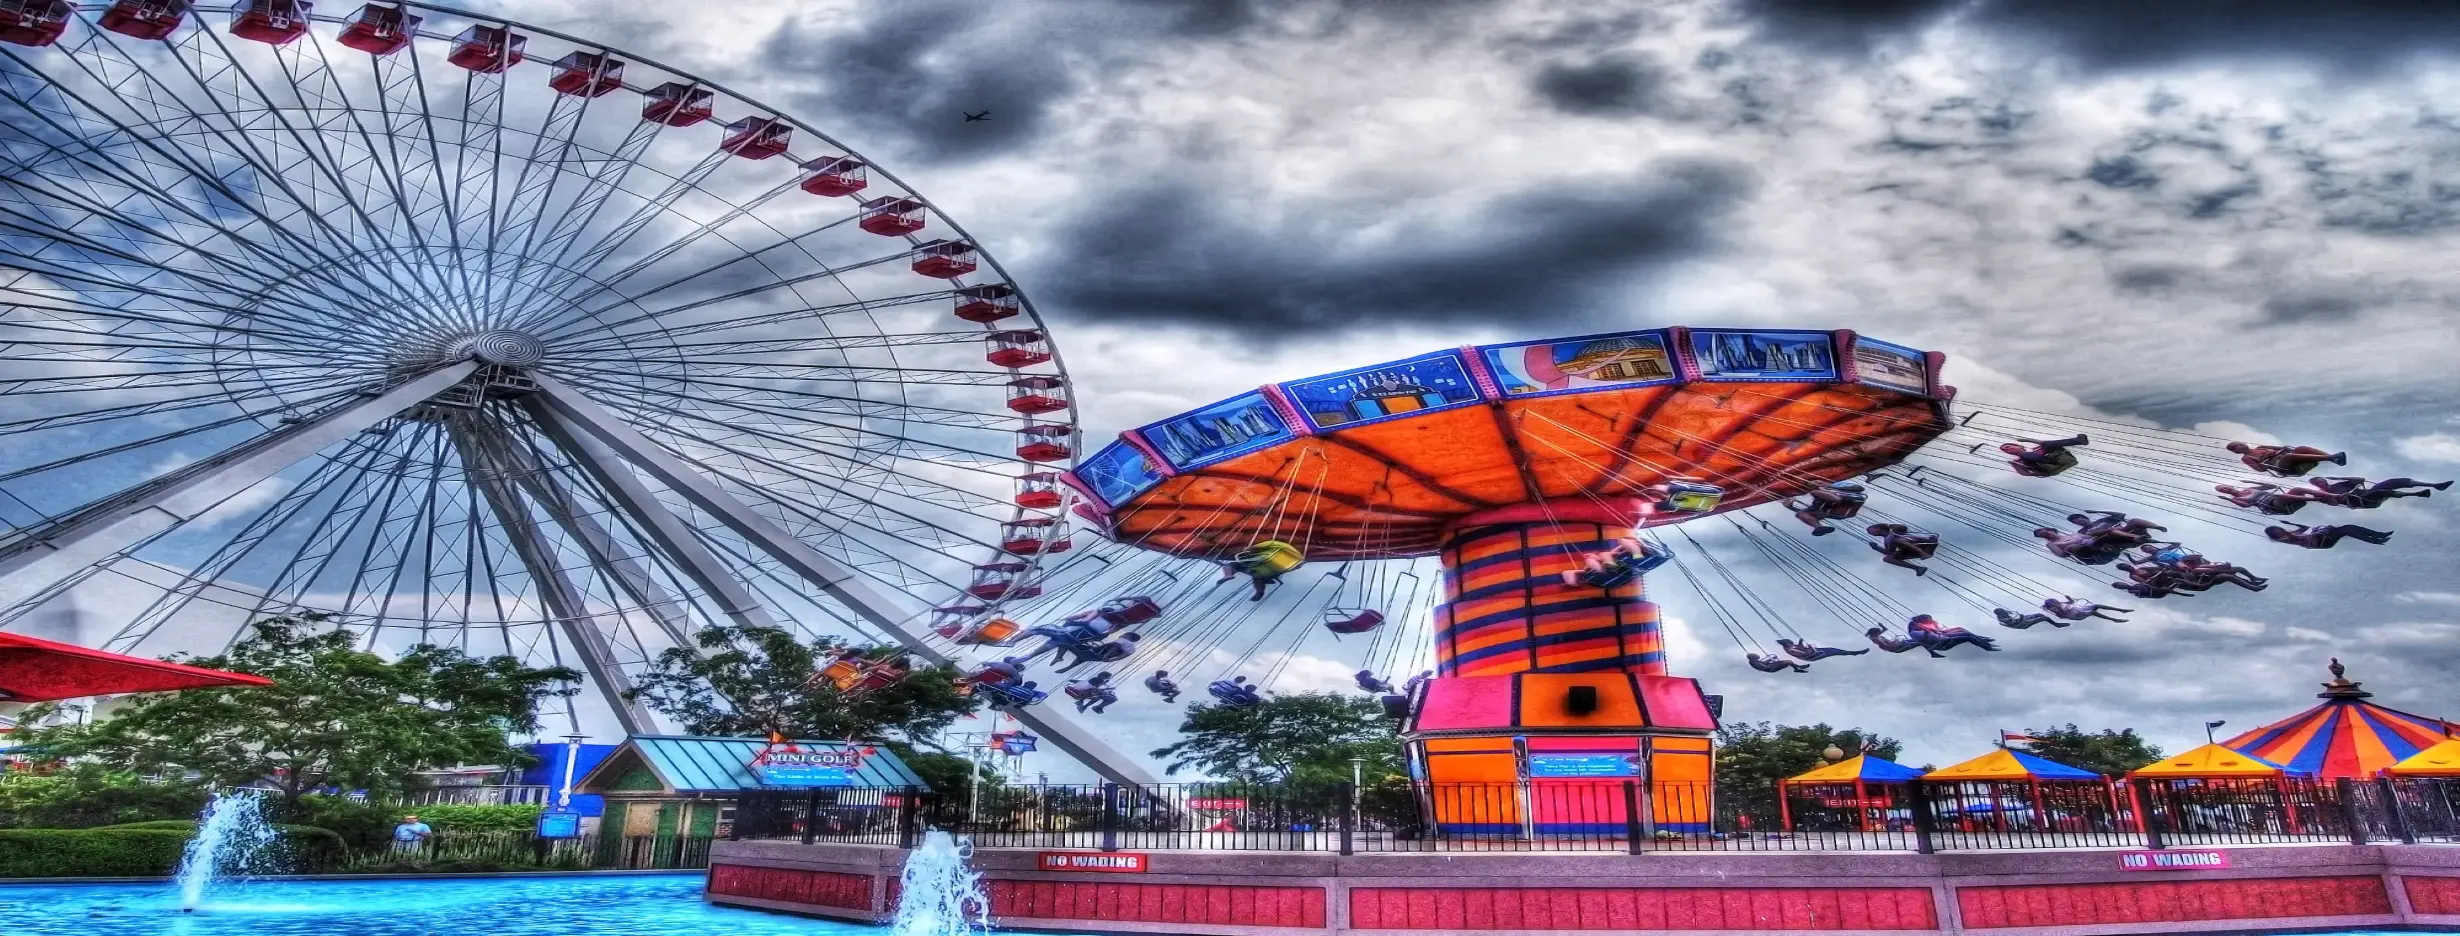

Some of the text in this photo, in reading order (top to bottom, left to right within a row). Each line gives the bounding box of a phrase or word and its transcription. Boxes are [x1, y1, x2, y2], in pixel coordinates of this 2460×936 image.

[766, 754, 852, 763] MINI GOLF
[1046, 855, 1138, 868] NO WADING
[2123, 852, 2222, 867] NO WADING
